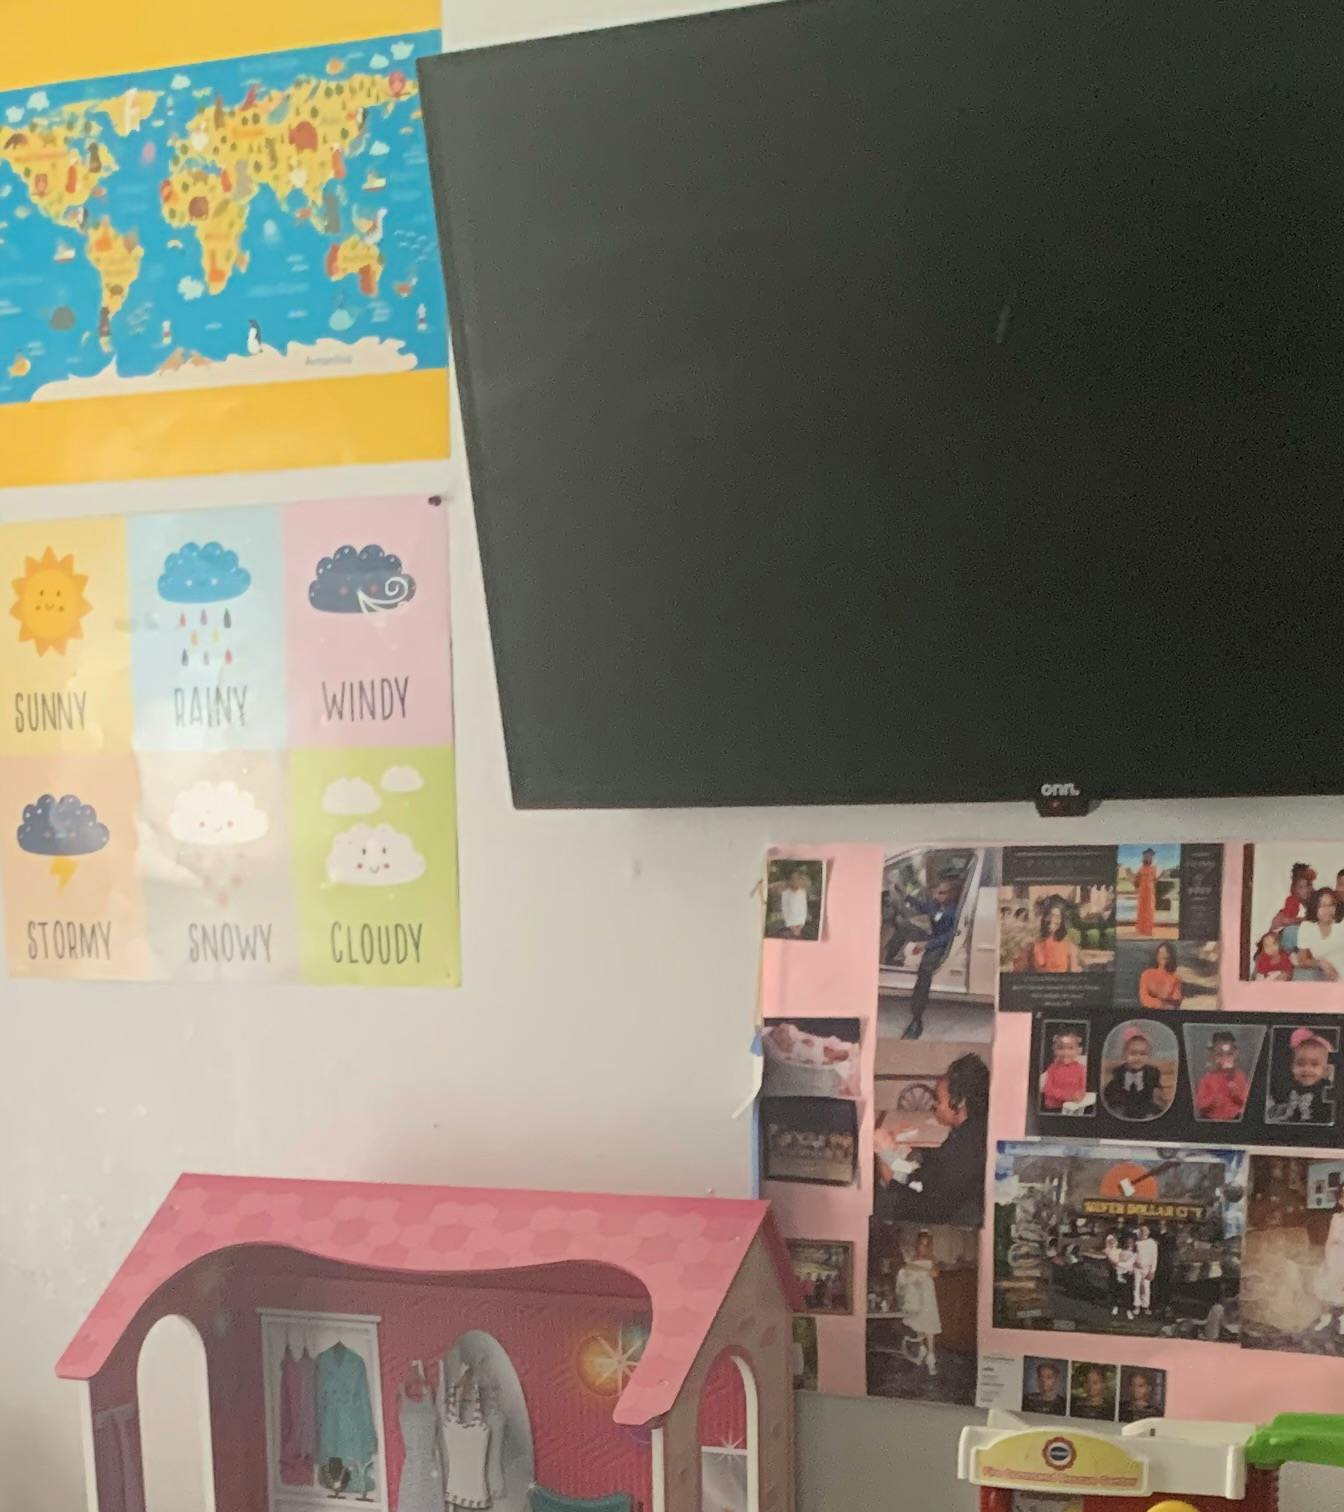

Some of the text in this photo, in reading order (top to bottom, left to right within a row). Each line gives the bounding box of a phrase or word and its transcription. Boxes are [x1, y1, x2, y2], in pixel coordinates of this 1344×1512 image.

[14, 691, 88, 733] SUNNY
[173, 685, 249, 729] RAINY
[321, 676, 411, 724] WINDY
[26, 920, 113, 964] STORMY
[188, 922, 273, 965] SNOWY
[330, 920, 425, 966] CLOUDY
